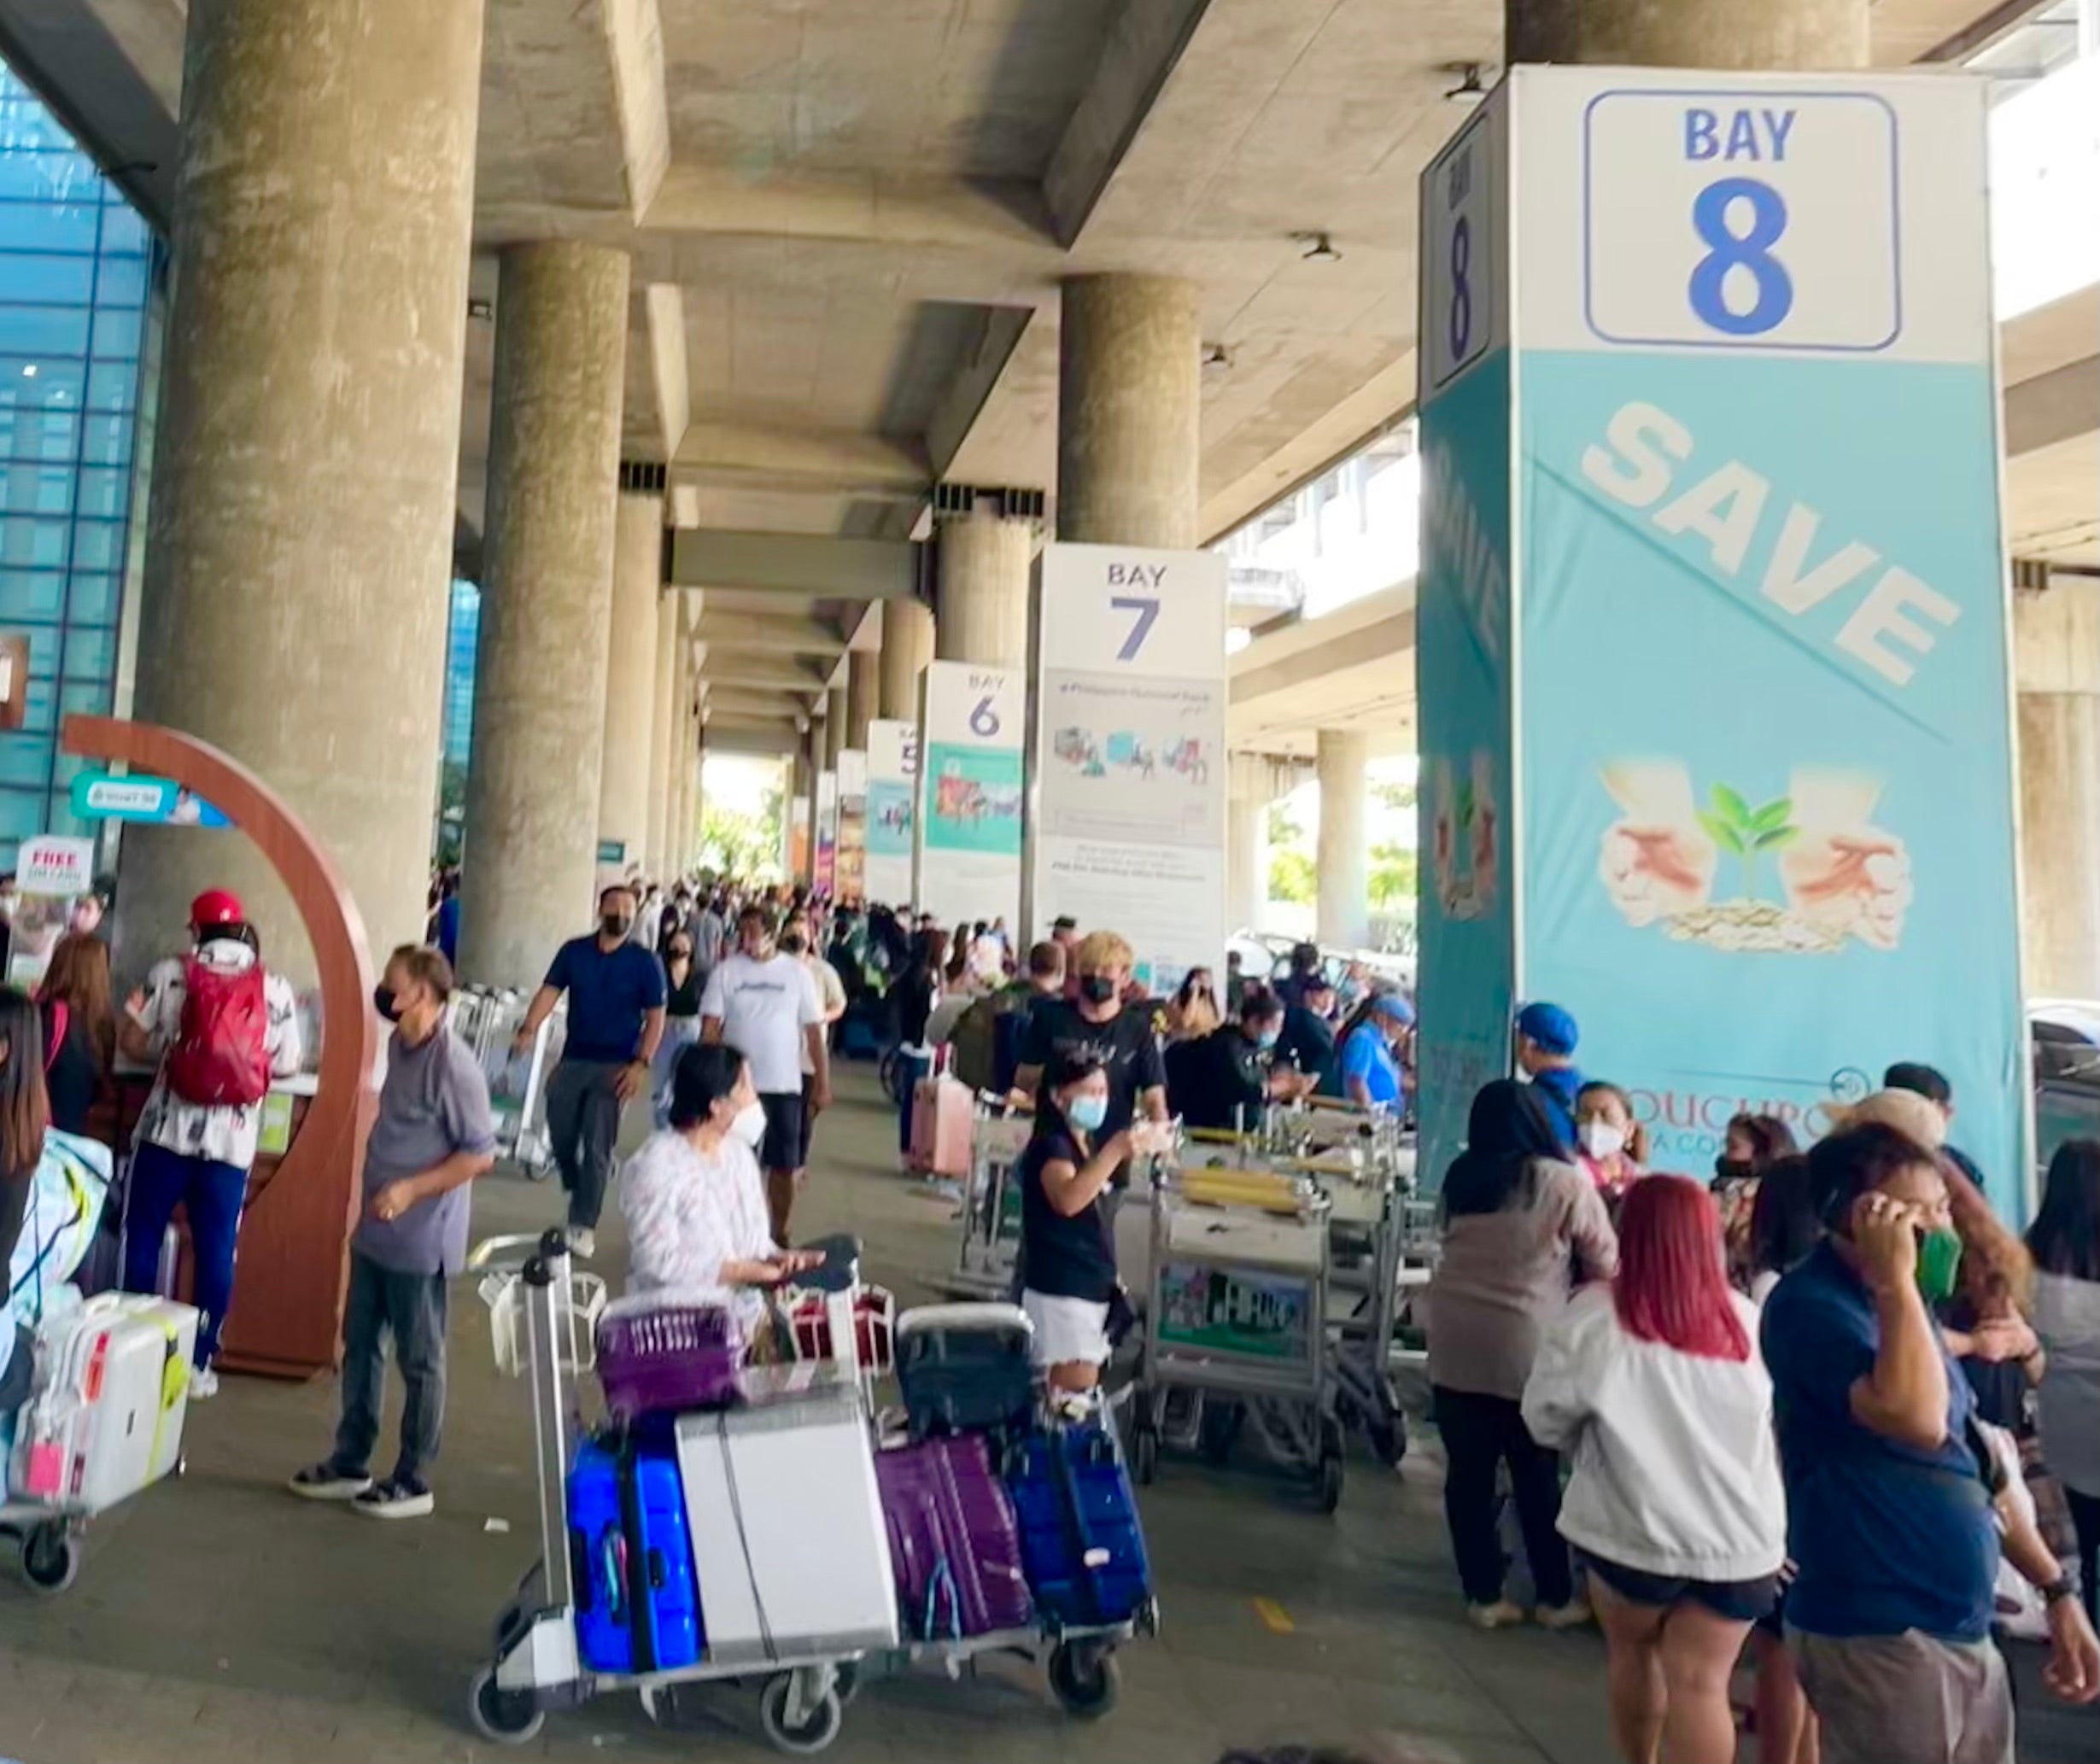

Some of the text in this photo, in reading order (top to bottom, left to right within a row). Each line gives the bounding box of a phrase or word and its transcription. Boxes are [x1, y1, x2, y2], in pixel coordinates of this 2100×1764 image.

[1684, 108, 1796, 161] BAY
[1688, 177, 1793, 336] 8
[1451, 215, 1470, 362] 8
[1581, 400, 1961, 686] SAVE
[1108, 564, 1167, 587] BAY
[1111, 597, 1161, 661] 7
[969, 674, 1005, 691] BAY
[969, 695, 1000, 737] 6
[32, 850, 78, 867] FREE
